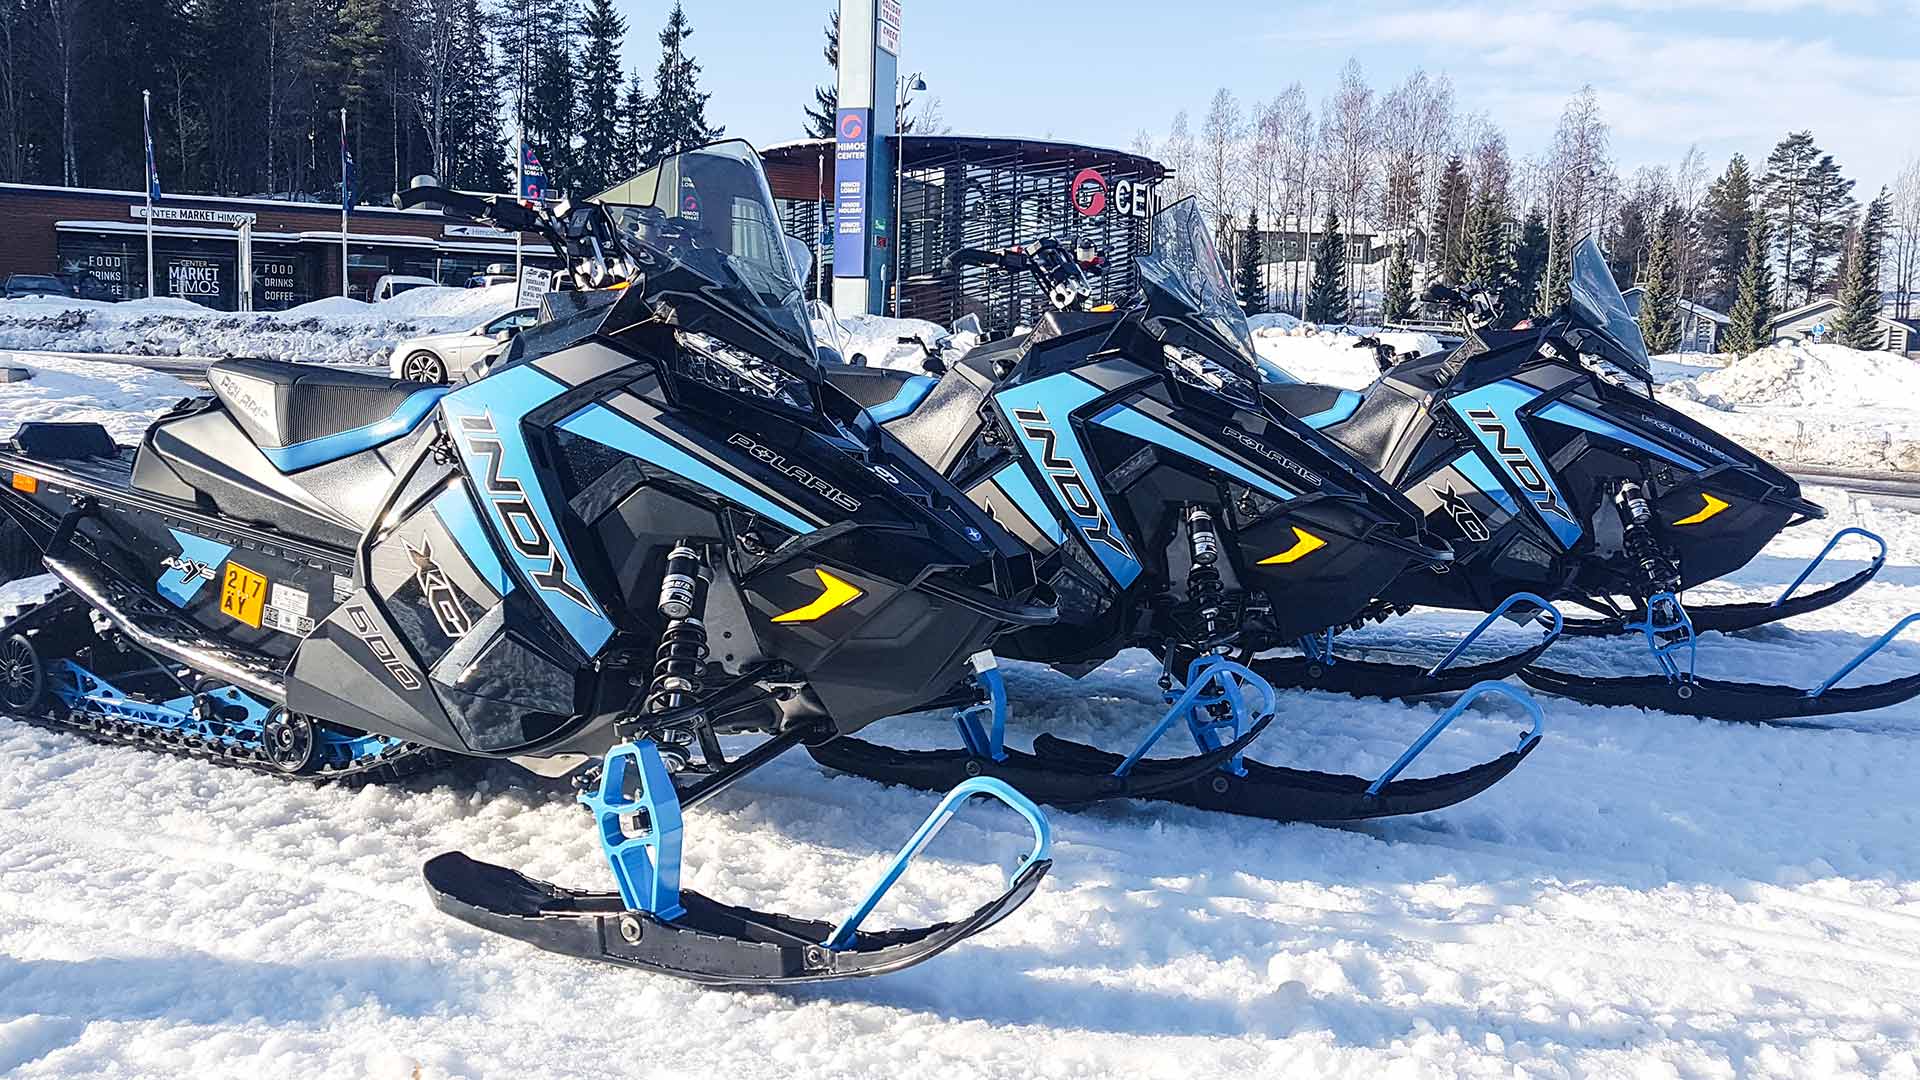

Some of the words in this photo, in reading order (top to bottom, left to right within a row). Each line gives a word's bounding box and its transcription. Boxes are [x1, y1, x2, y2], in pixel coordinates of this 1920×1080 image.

[837, 142, 866, 151] HIMOS
[837, 151, 866, 160] CENTER
[139, 208, 177, 218] CNTER
[179, 210, 216, 221] MARKET
[89, 256, 121, 267] FOOD
[180, 260, 208, 268] CENTER
[264, 263, 294, 275] FOOD
[168, 266, 219, 281] MARKET
[168, 280, 220, 294] HIMOS
[264, 277, 294, 288] DRINKS
[264, 291, 295, 301] COFFEE
[1222, 425, 1322, 487] POLARIS
[727, 432, 861, 512] POLARIS
[1464, 405, 1576, 526] INDY
[1011, 402, 1133, 561] INDY
[459, 405, 602, 617] INDY
[1425, 480, 1490, 542] XC
[228, 571, 262, 598] 217
[398, 528, 473, 638] XC
[344, 604, 421, 690] 600
